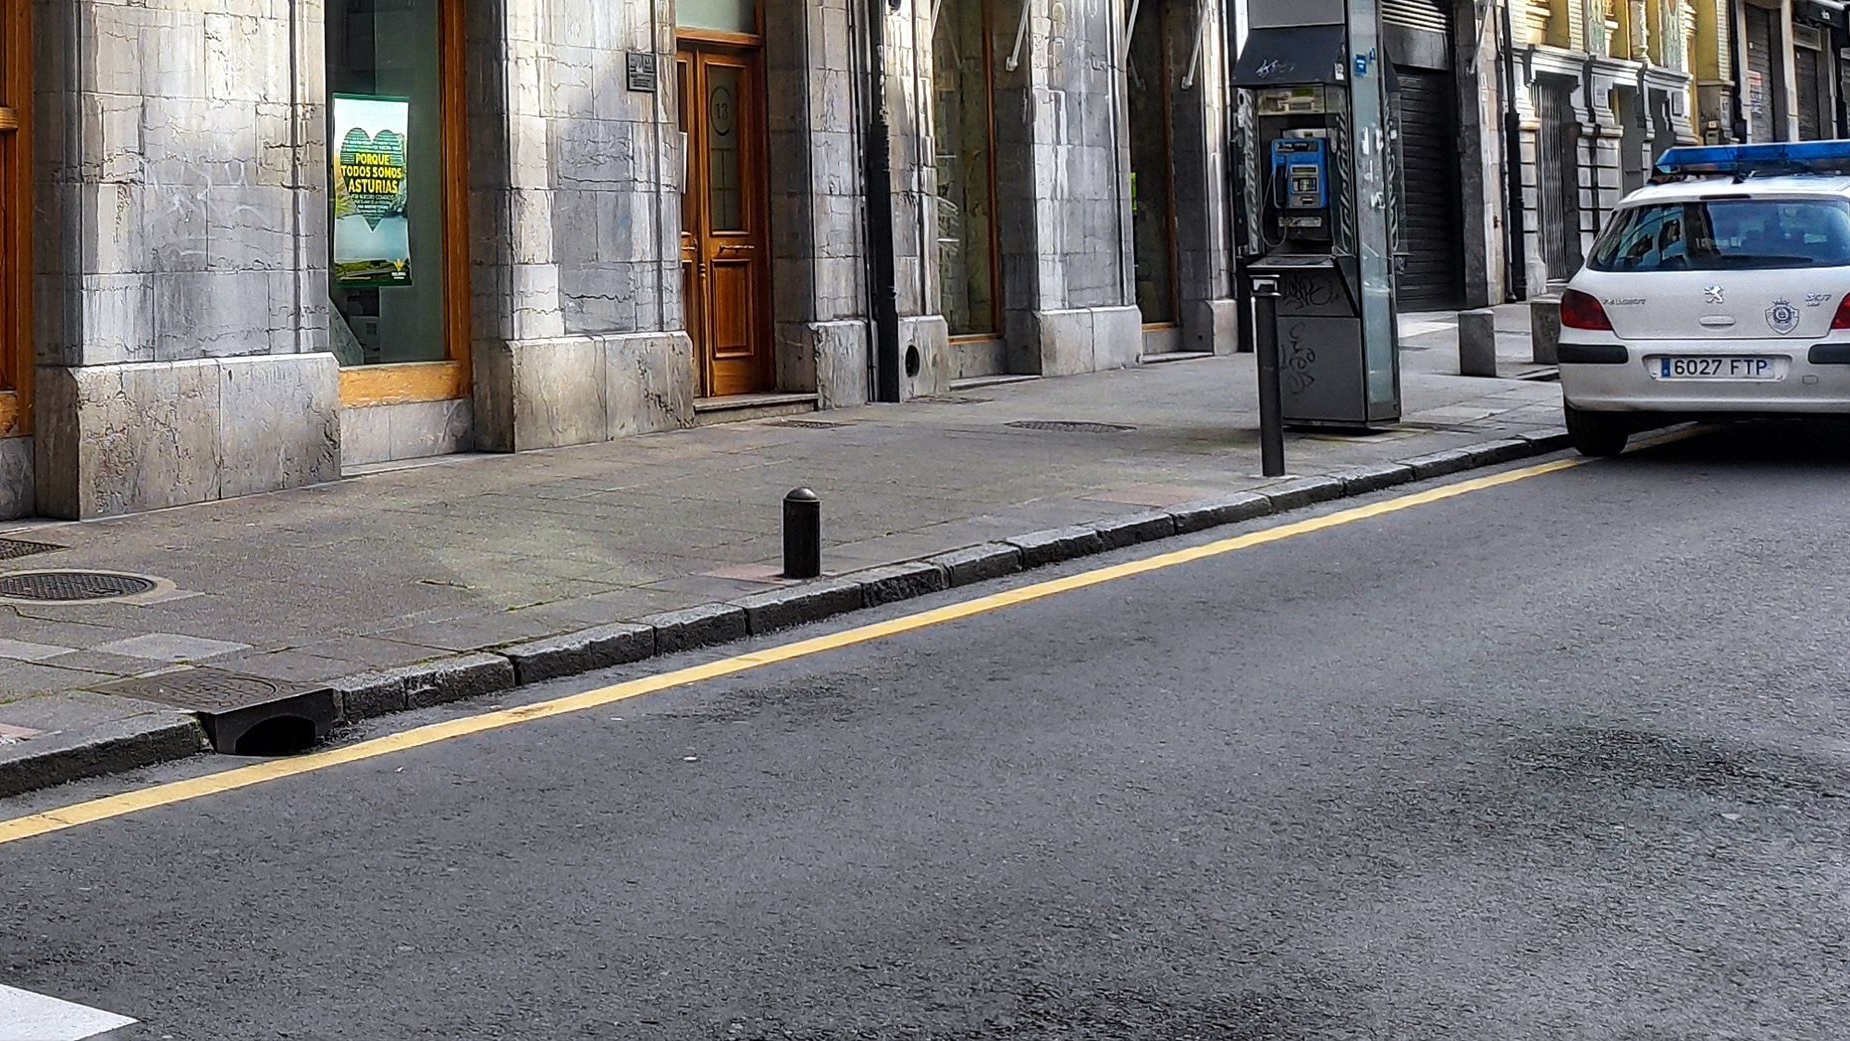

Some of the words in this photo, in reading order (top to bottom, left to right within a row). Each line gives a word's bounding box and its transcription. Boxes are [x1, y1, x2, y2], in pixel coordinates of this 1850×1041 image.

[355, 153, 390, 165] PORQUE
[341, 165, 371, 177] TODOS
[372, 166, 402, 179] SOMOS
[348, 178, 398, 193] ASTURIAS
[1674, 359, 1723, 376] 6027
[1730, 359, 1768, 376] FTP
